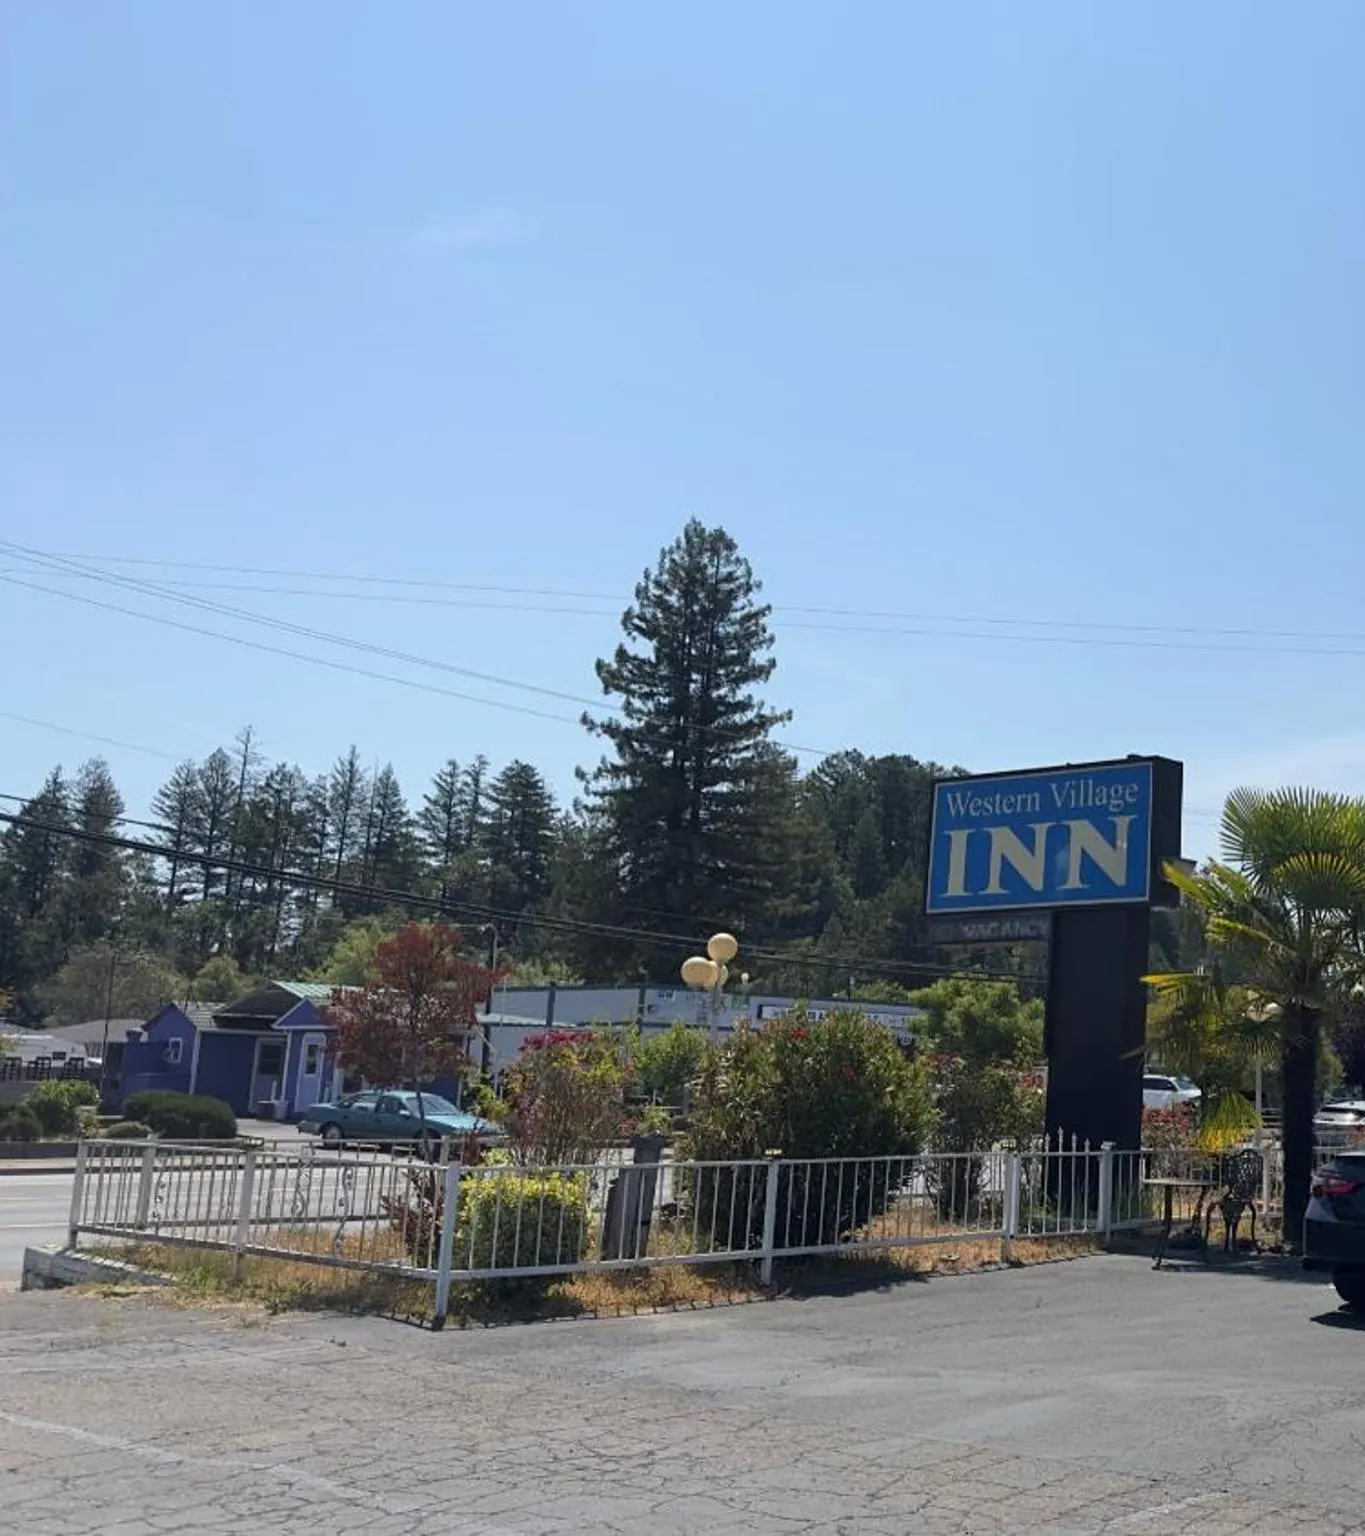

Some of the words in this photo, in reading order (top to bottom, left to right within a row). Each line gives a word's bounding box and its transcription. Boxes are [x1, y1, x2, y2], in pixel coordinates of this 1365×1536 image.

[946, 791, 1040, 817] Western
[1049, 778, 1139, 813] Village
[940, 814, 1138, 897] INN
